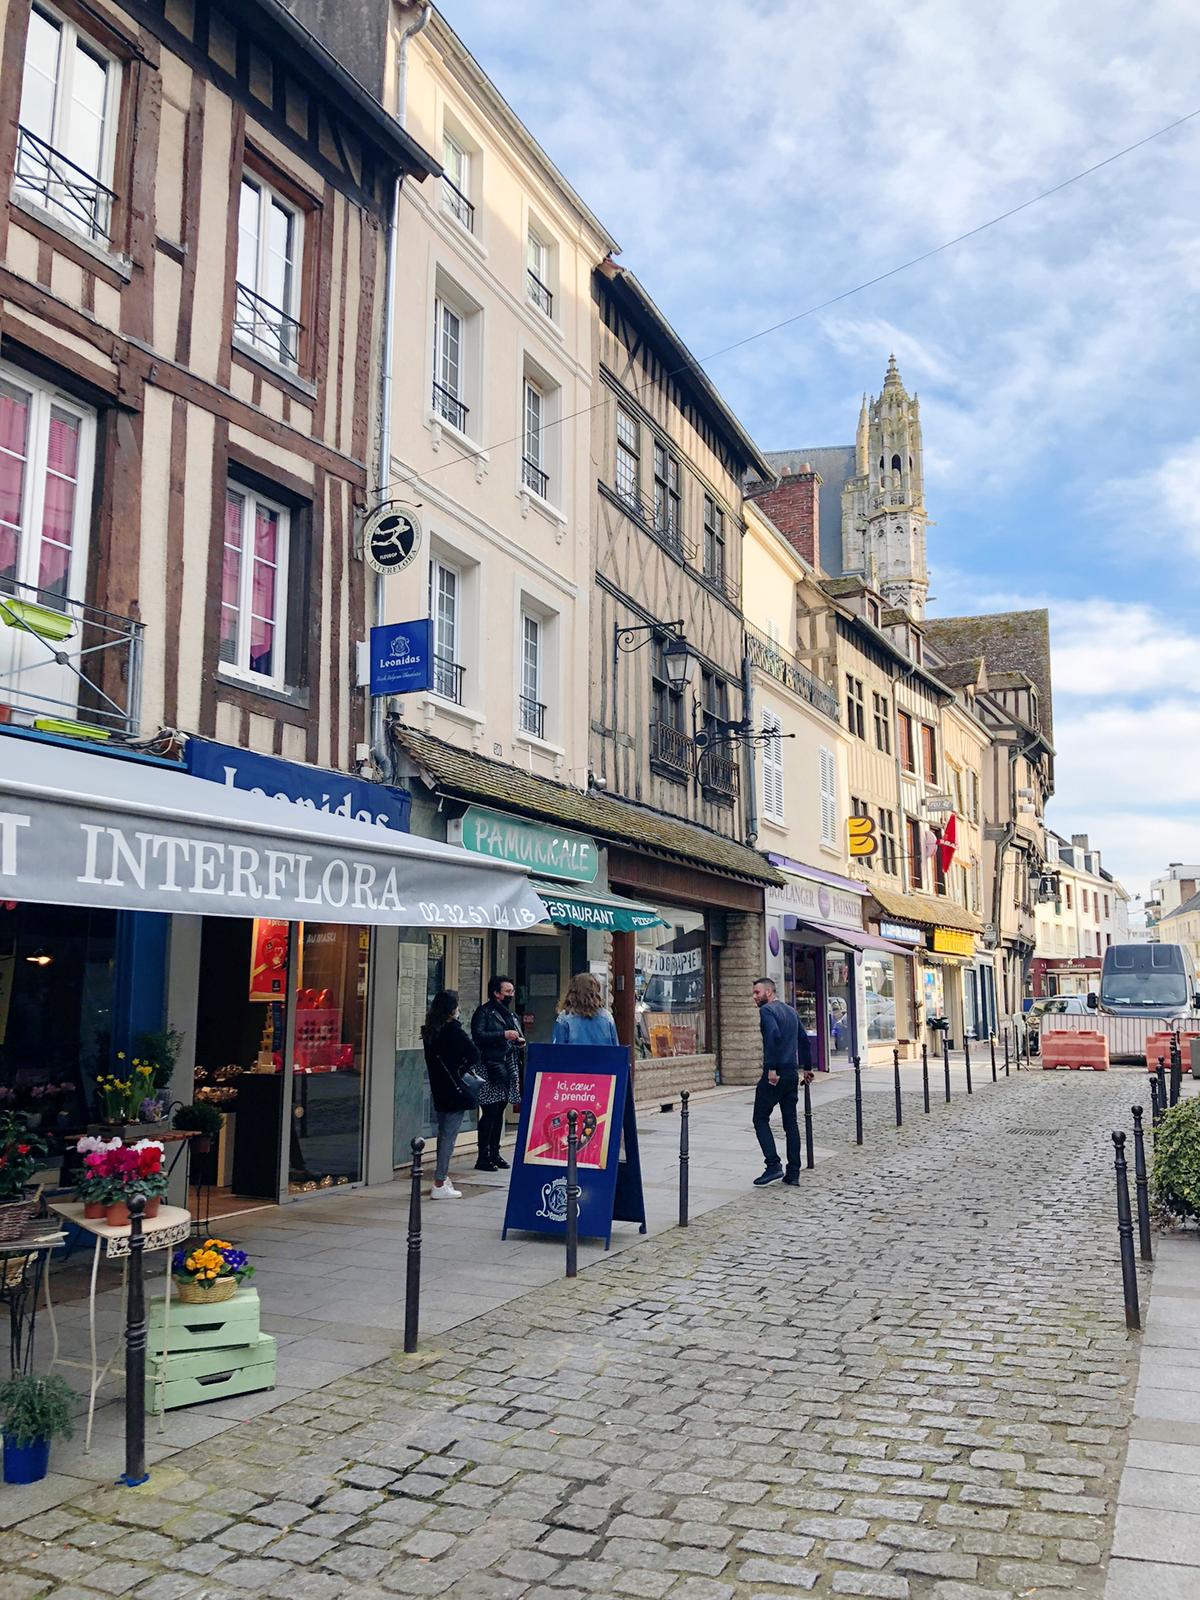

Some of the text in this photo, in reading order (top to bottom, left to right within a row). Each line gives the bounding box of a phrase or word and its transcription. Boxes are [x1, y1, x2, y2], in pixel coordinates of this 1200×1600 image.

[370, 550, 417, 574] INTERFLORA
[380, 655, 421, 668] Leonidas
[77, 823, 407, 913] INTERFLORA
[418, 901, 445, 922] 02
[444, 903, 469, 924] 32
[557, 1080, 595, 1093] Ici, cœur
[553, 1091, 596, 1103] à prendre
